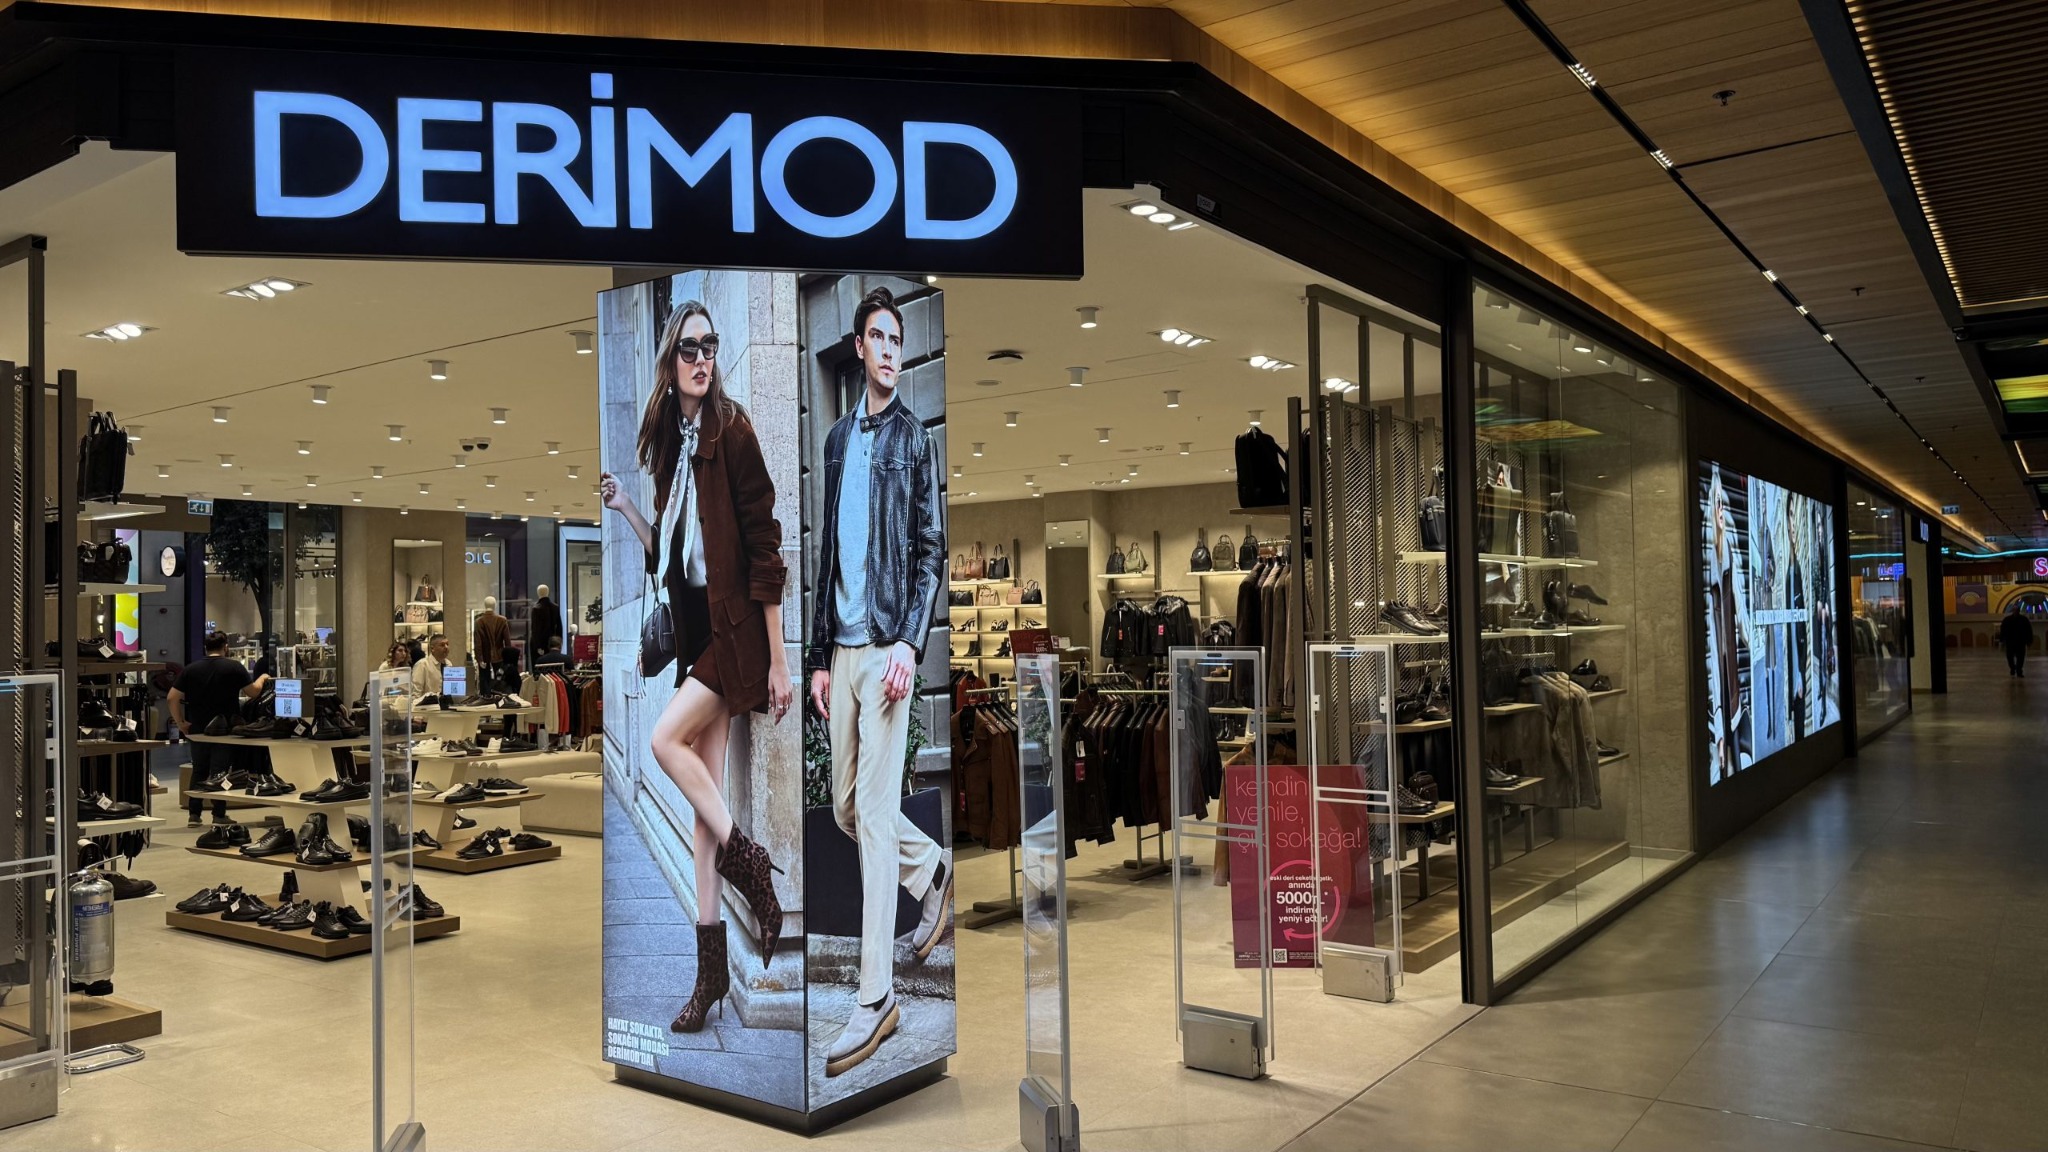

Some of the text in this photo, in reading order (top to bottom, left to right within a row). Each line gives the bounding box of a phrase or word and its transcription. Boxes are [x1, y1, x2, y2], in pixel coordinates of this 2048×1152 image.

[254, 73, 1019, 241] DERİMOD
[1235, 775, 1311, 797] kendin
[607, 1017, 629, 1033] HAYAT
[607, 1031, 670, 1057] SOKAĞIN MODASI
